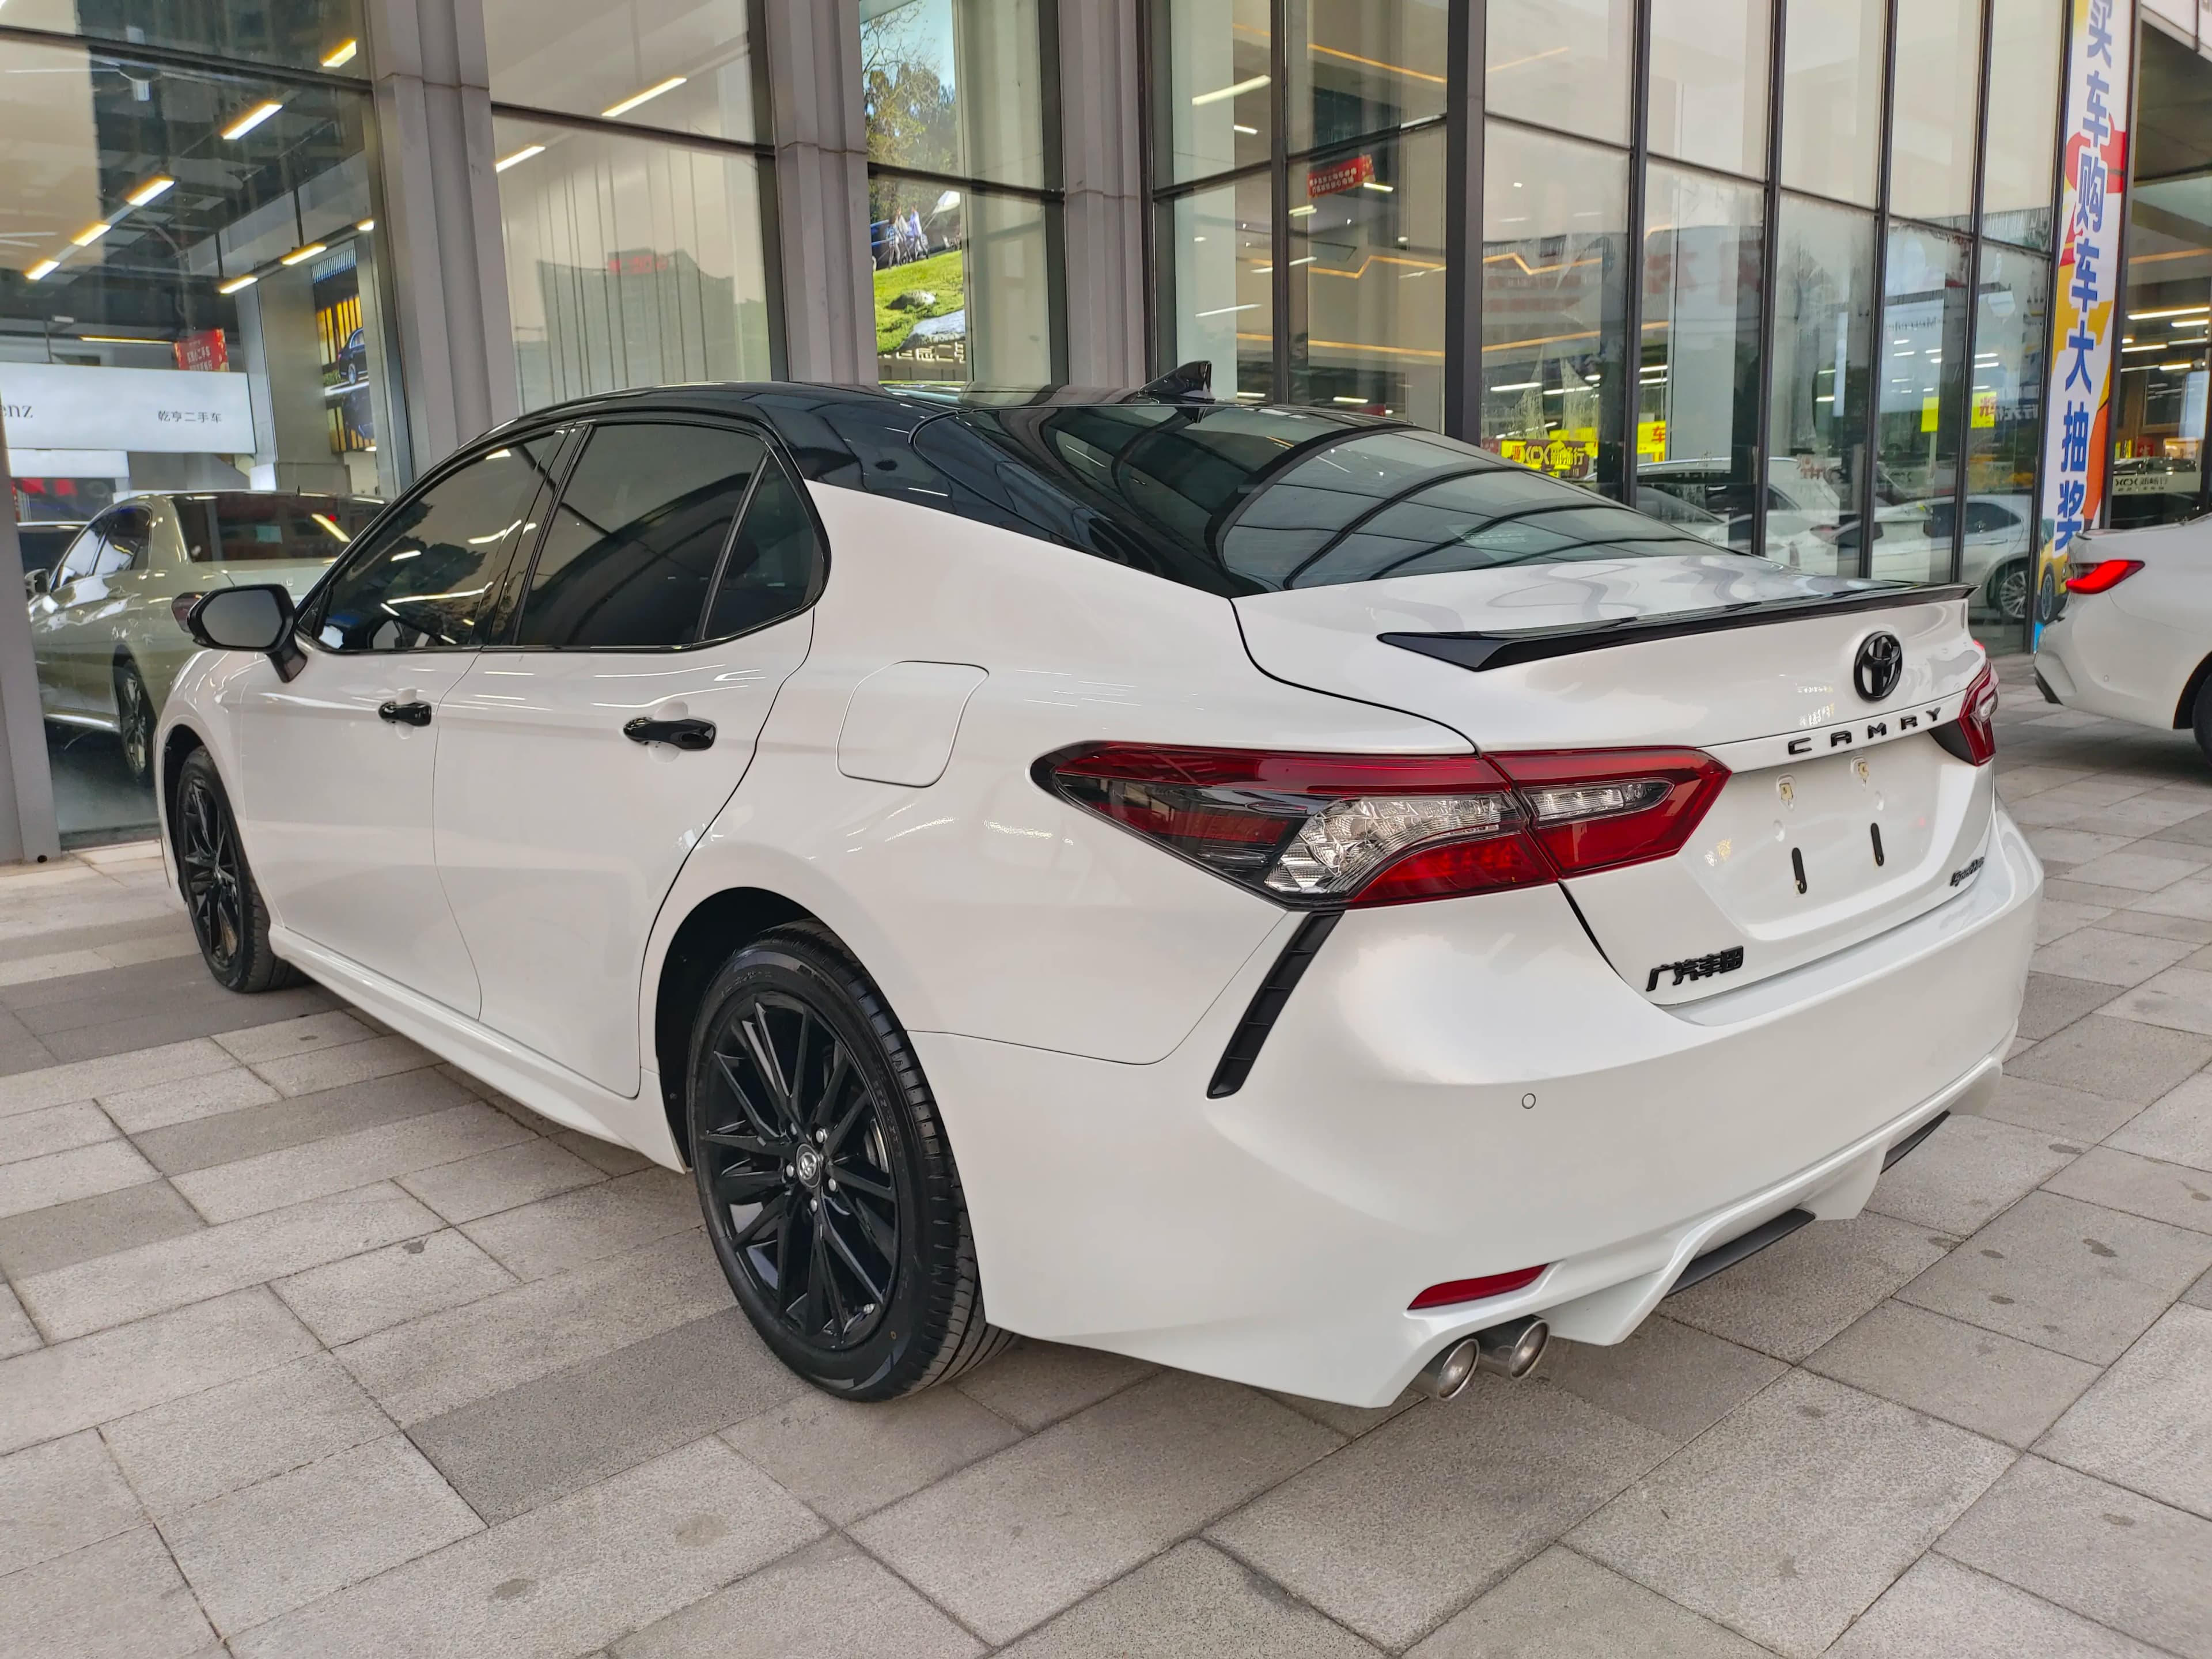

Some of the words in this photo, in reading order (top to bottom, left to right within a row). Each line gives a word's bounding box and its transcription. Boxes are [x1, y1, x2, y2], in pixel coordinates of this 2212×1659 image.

[2054, 0, 2113, 552] 买车购车大抽奖
[158, 410, 222, 424] 乾亨二手车
[1788, 707, 1941, 755] CAMRY
[1646, 945, 1744, 992] 广汽丰田
